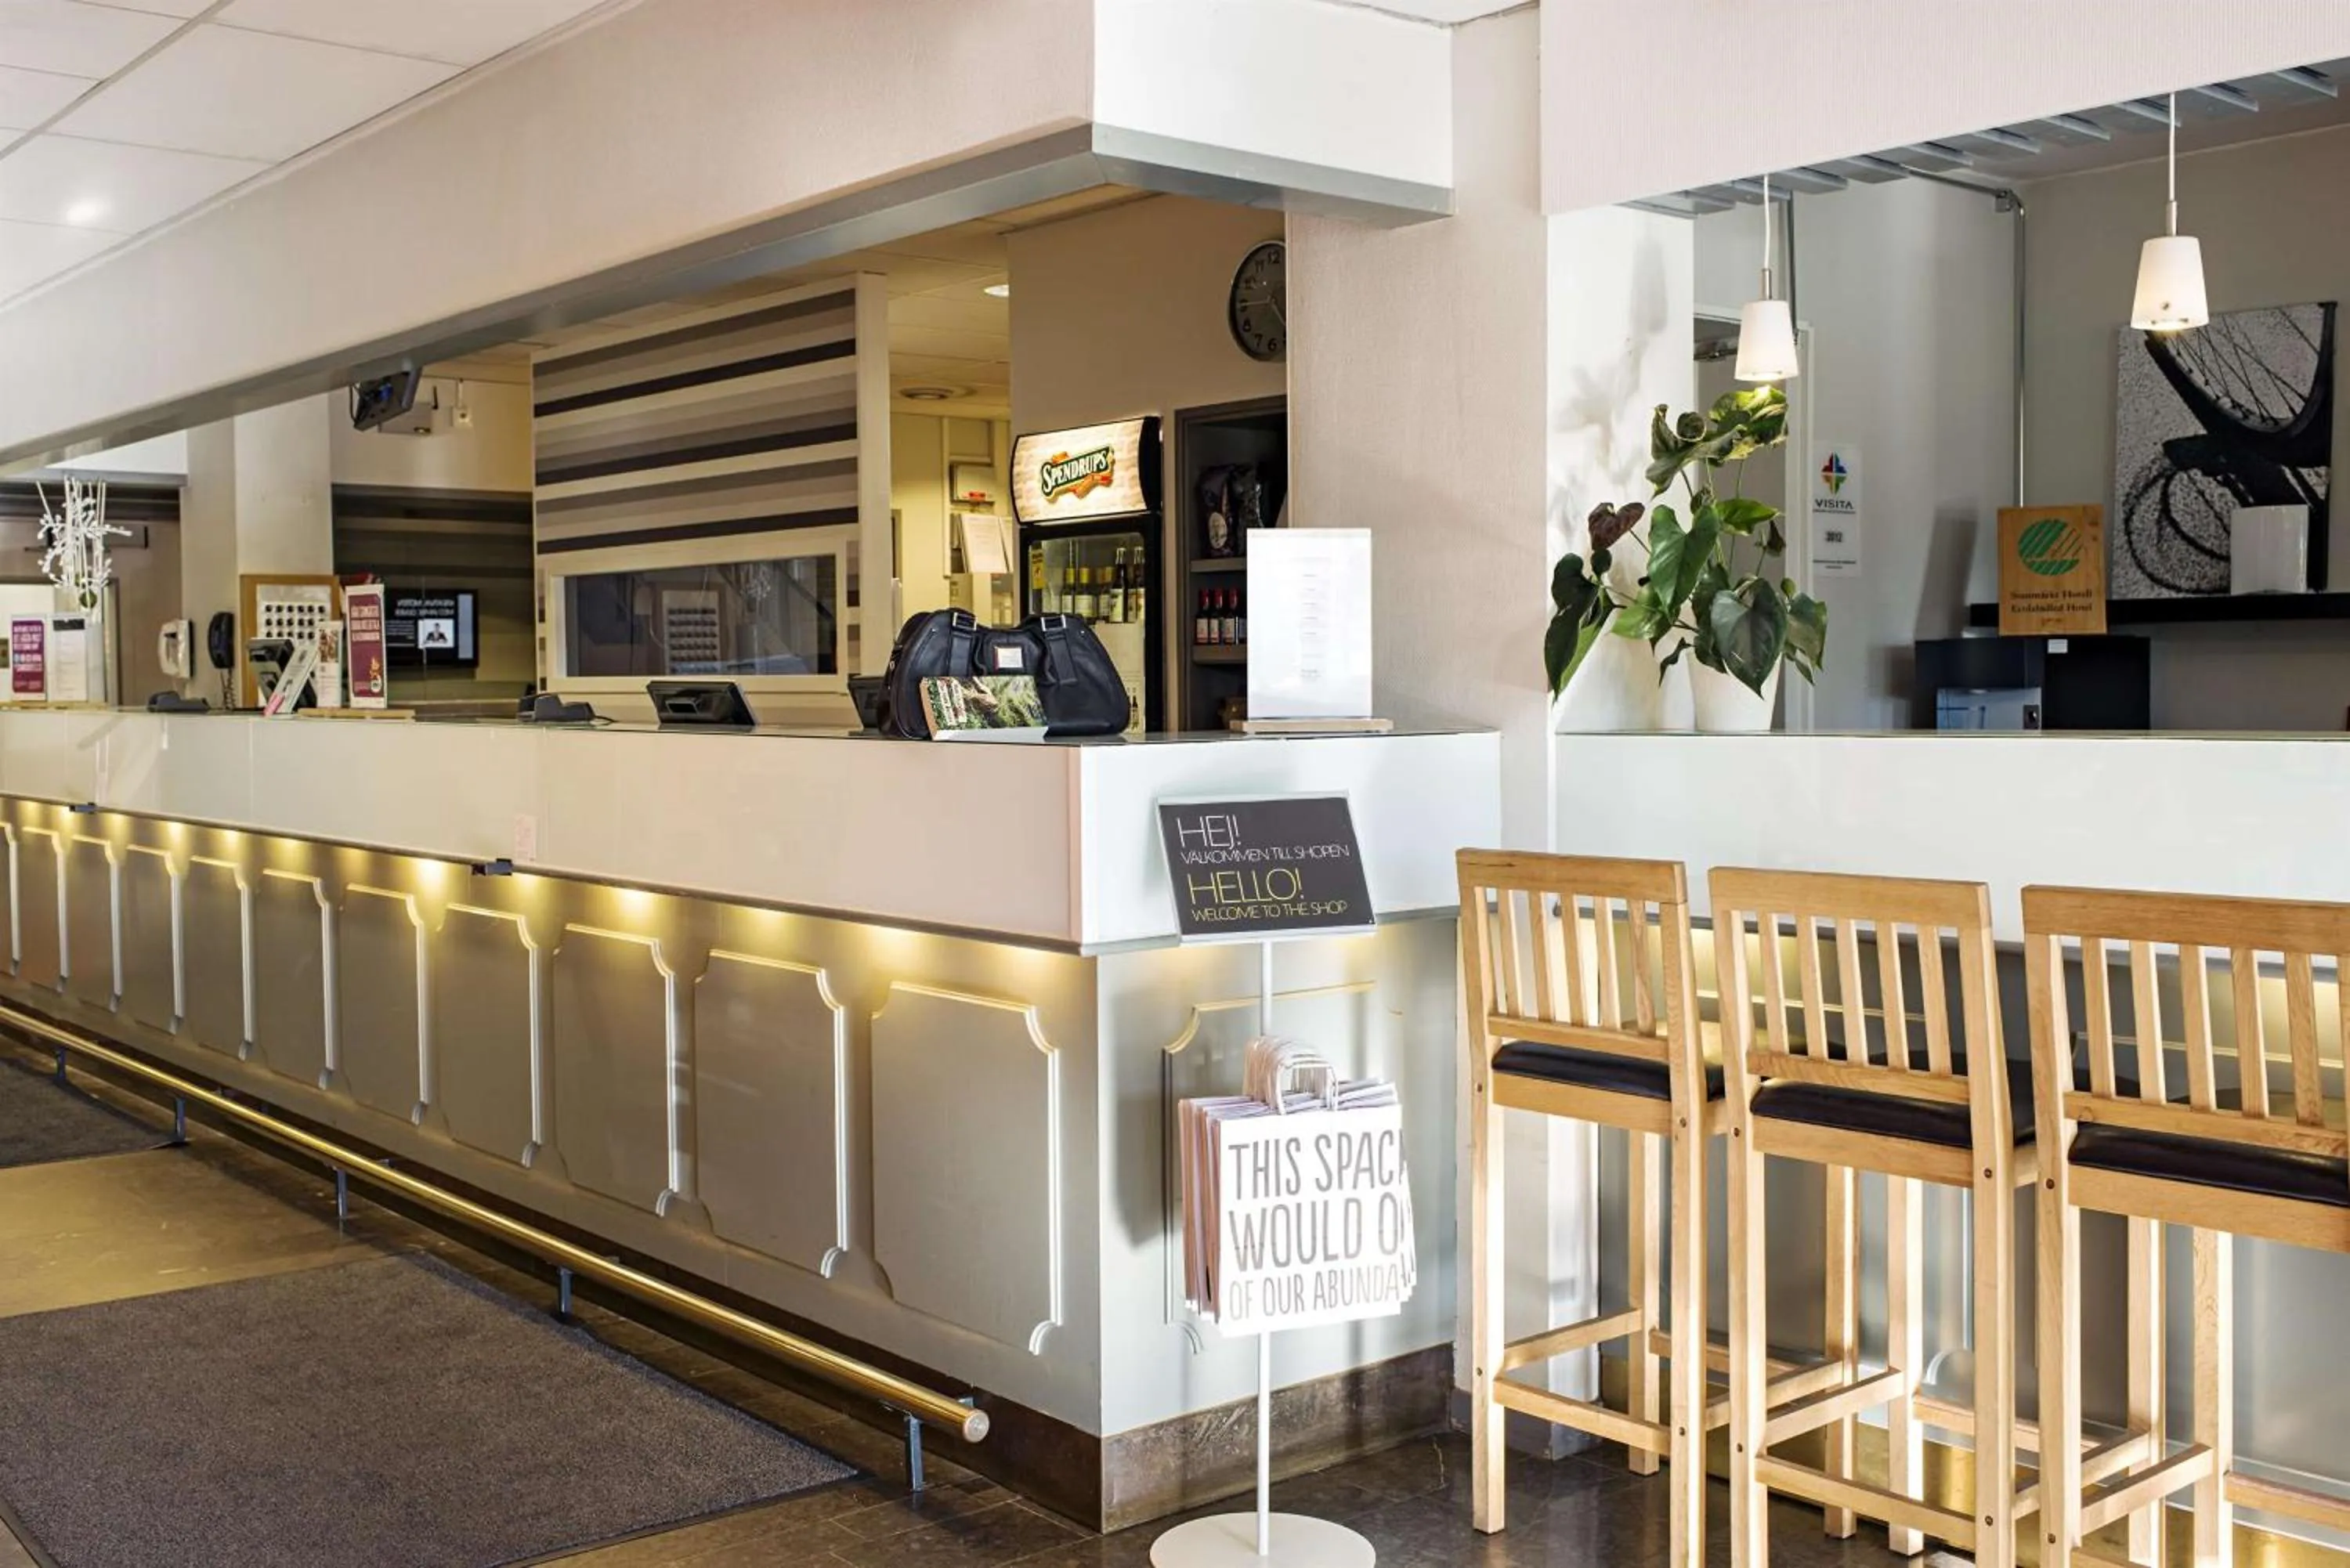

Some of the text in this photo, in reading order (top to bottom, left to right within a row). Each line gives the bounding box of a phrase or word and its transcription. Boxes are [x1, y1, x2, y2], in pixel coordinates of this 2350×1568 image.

[1254, 334, 1264, 348] 7
[1267, 338, 1277, 352] 6
[1043, 450, 1107, 493] SPENDRUPS
[1815, 499, 1853, 510] VISITA
[1177, 815, 1242, 850] HEJ!
[1271, 846, 1293, 860] TILL
[1187, 868, 1305, 905] HELLO!
[1191, 899, 1348, 922] WELCOME TO THE SHOP
[1227, 1136, 1301, 1200] THIS
[1227, 1197, 1362, 1273] WOULD
[1228, 1277, 1254, 1321] OF
[1262, 1272, 1305, 1317] OUR
